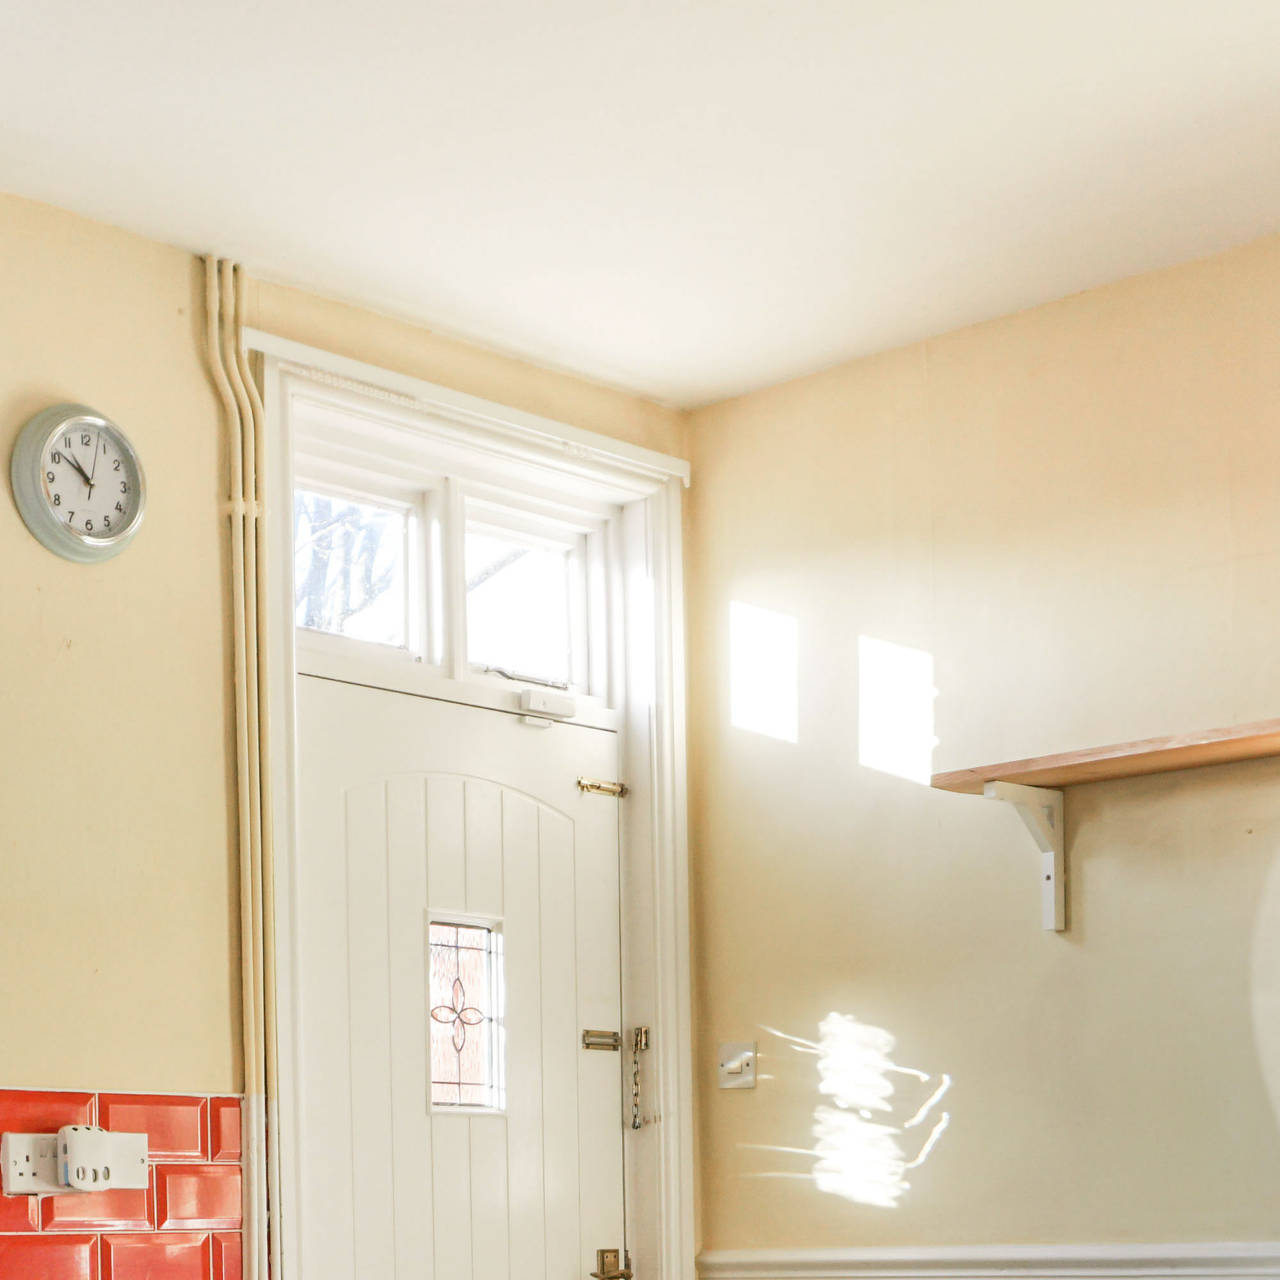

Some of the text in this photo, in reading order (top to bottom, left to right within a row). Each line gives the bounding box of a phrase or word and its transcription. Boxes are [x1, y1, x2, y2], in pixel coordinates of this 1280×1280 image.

[64, 437, 71, 448] 11
[81, 434, 91, 446] 12
[51, 452, 60, 464] 10
[113, 459, 120, 471] 2
[47, 472, 55, 483] 9
[120, 481, 127, 494] 3
[53, 495, 61, 506] 8
[115, 501, 122, 512] 4
[68, 511, 75, 523] 7
[103, 516, 110, 527] 5
[85, 519, 93, 531] 6
